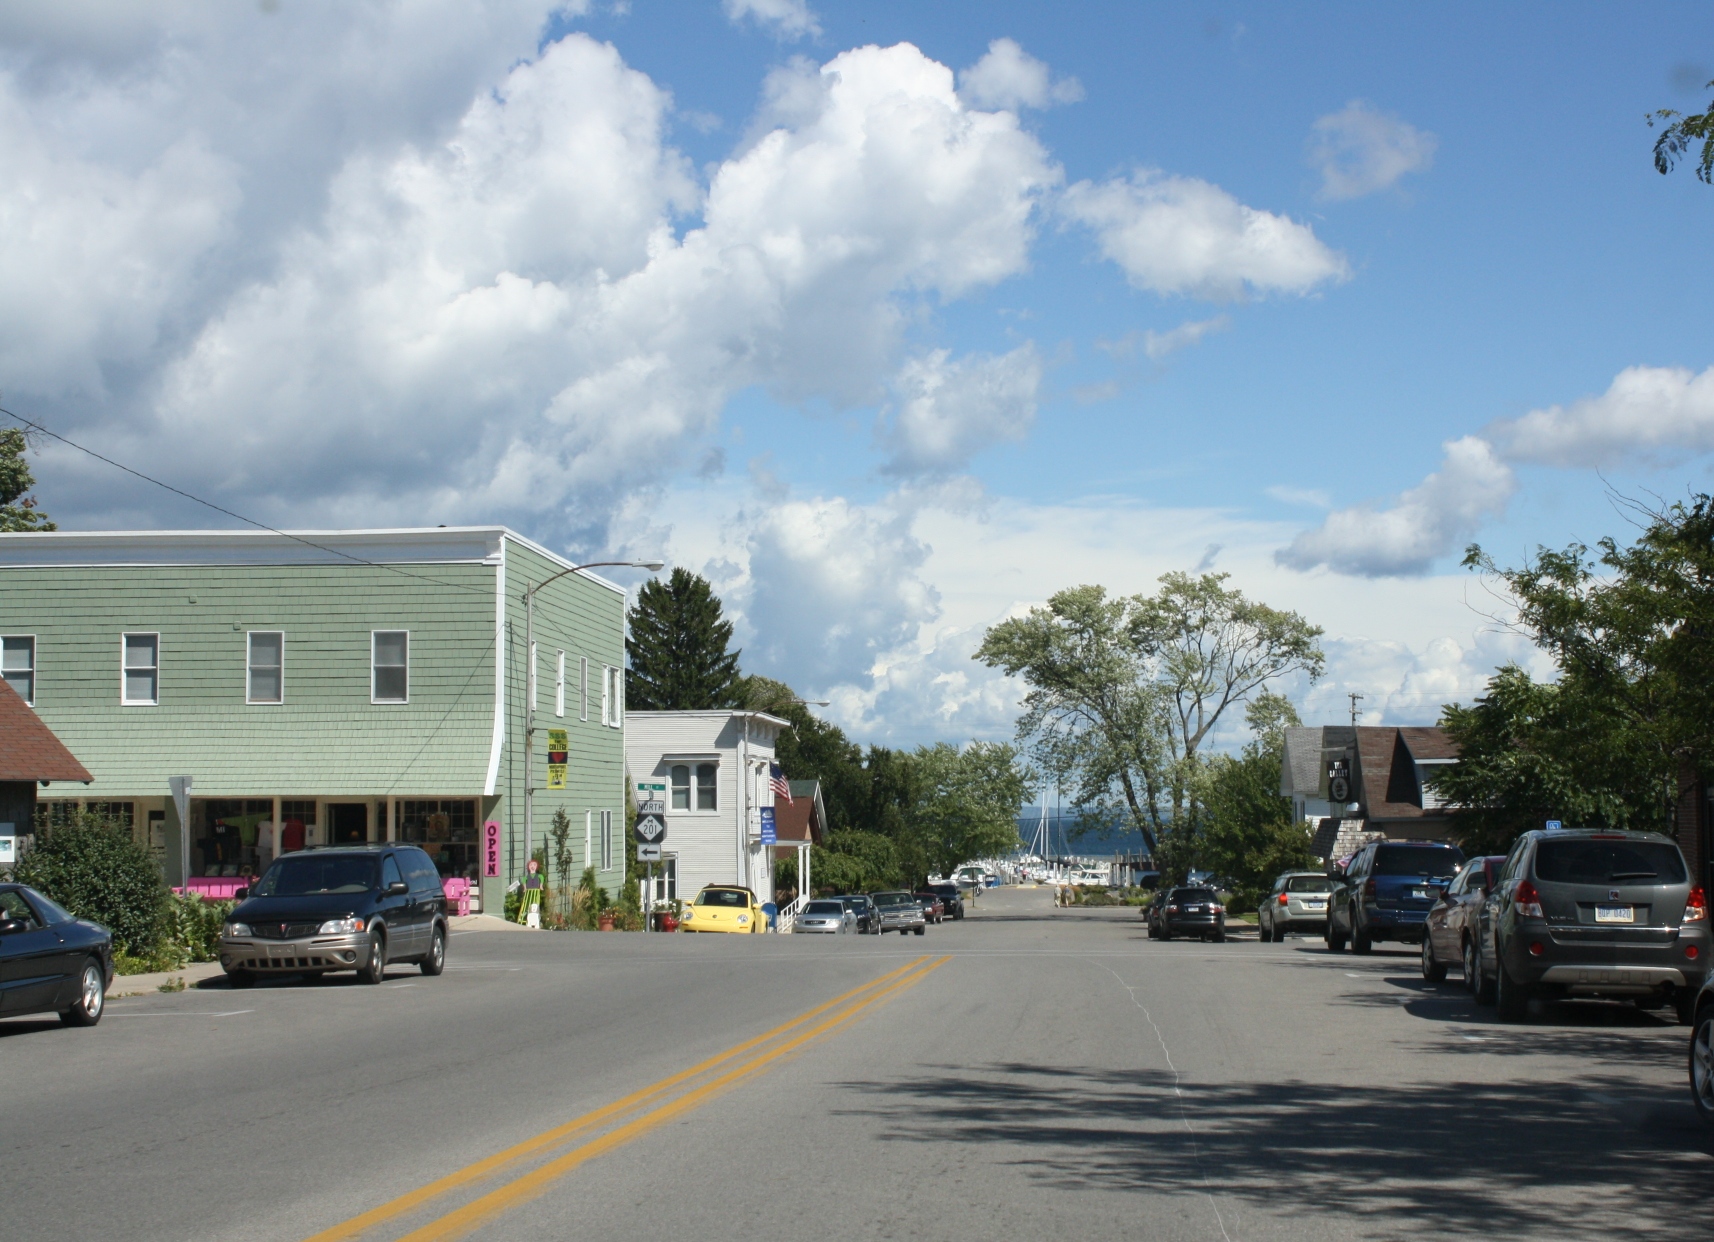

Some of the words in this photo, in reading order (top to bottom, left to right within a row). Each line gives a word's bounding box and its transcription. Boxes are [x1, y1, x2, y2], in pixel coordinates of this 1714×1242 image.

[638, 803, 663, 811] NORTH
[643, 824, 657, 835] 201
[487, 825, 497, 875] OPEN
